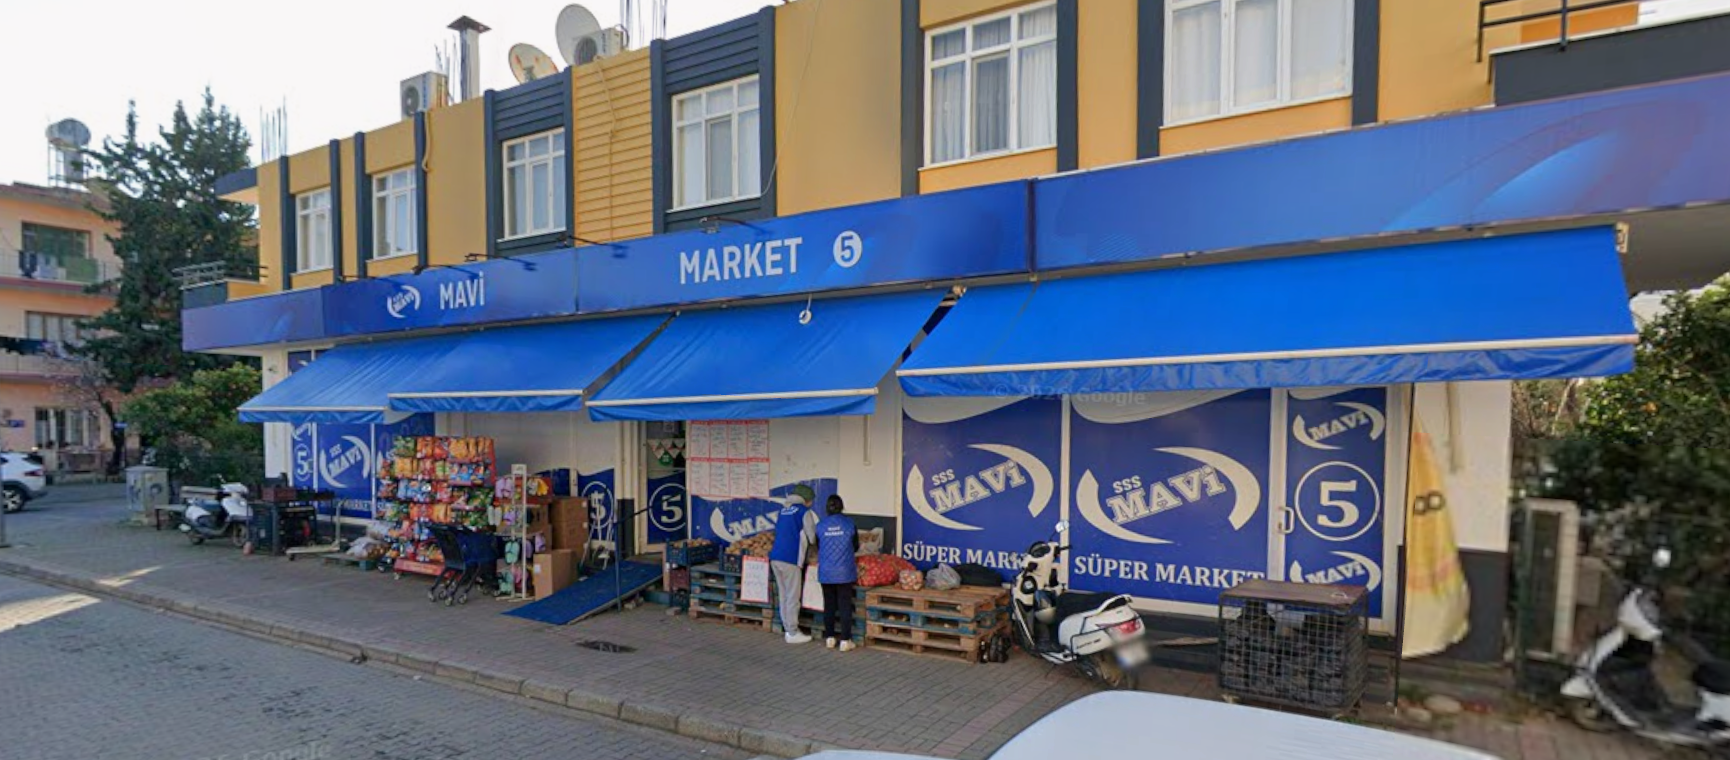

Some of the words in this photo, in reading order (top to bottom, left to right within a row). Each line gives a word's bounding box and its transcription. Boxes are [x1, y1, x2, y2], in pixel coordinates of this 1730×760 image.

[679, 237, 803, 285] MARKET
[297, 450, 307, 475] 5
[660, 494, 683, 523] 5
[1317, 480, 1359, 528] 5
[903, 541, 961, 564] SÜPER
[966, 548, 1028, 570] MARK
[1074, 553, 1149, 581] SÜPER
